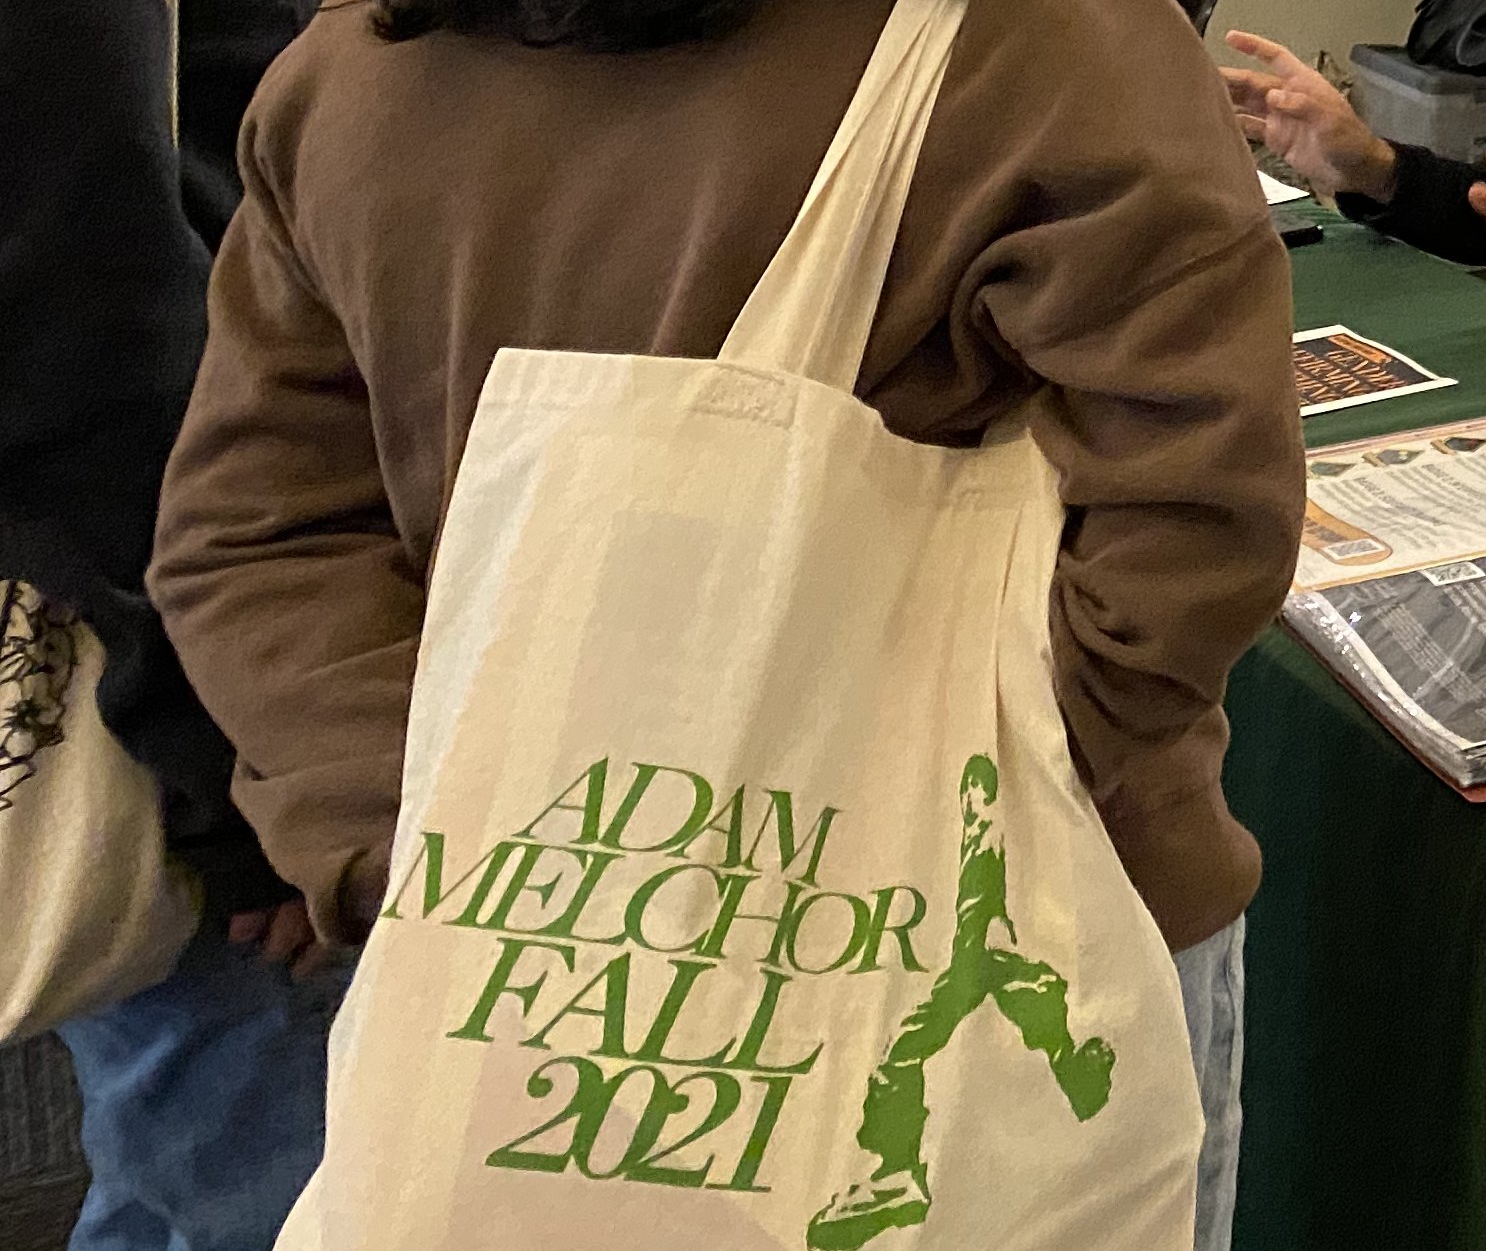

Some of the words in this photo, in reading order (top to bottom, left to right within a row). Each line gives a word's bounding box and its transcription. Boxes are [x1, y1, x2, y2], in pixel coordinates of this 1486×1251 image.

[512, 755, 843, 889] ADAM
[380, 830, 930, 975] MELCHOR
[446, 937, 824, 1076] FALL
[484, 1055, 795, 1194] 2021
